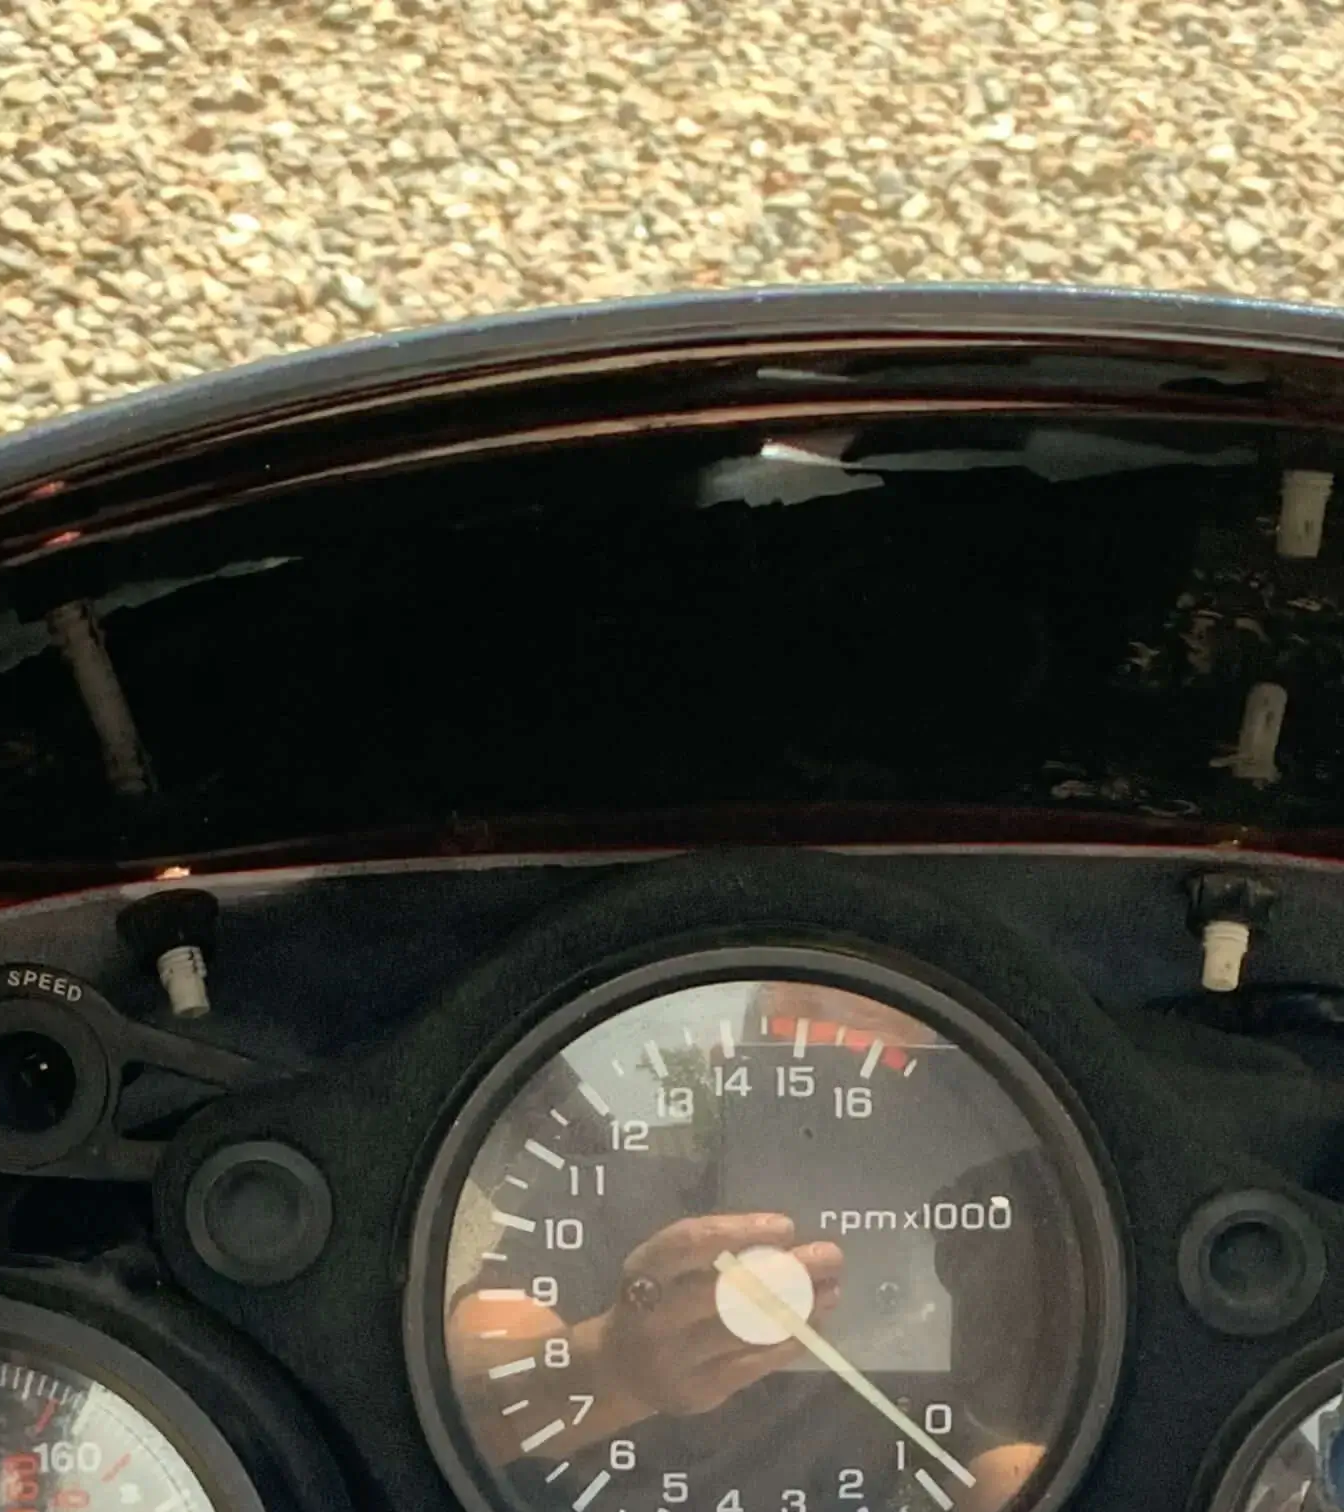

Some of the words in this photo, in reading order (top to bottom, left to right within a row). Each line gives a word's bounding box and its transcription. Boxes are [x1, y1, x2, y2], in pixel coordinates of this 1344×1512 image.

[7, 970, 84, 1003] SPEED
[714, 1066, 752, 1096] 14
[775, 1064, 816, 1096] 15
[658, 1087, 694, 1117] 13
[833, 1086, 873, 1118] 16
[611, 1119, 650, 1151] 12
[568, 1164, 606, 1196] 11
[543, 1218, 584, 1250] 10
[532, 1276, 558, 1307] 9
[543, 1338, 570, 1369] 8
[568, 1395, 594, 1425] 7
[925, 1404, 952, 1435] 0
[32, 1441, 103, 1474] 160
[609, 1440, 636, 1470] 6
[895, 1441, 906, 1470] 1
[662, 1473, 688, 1503] 5
[838, 1469, 865, 1499] 2
